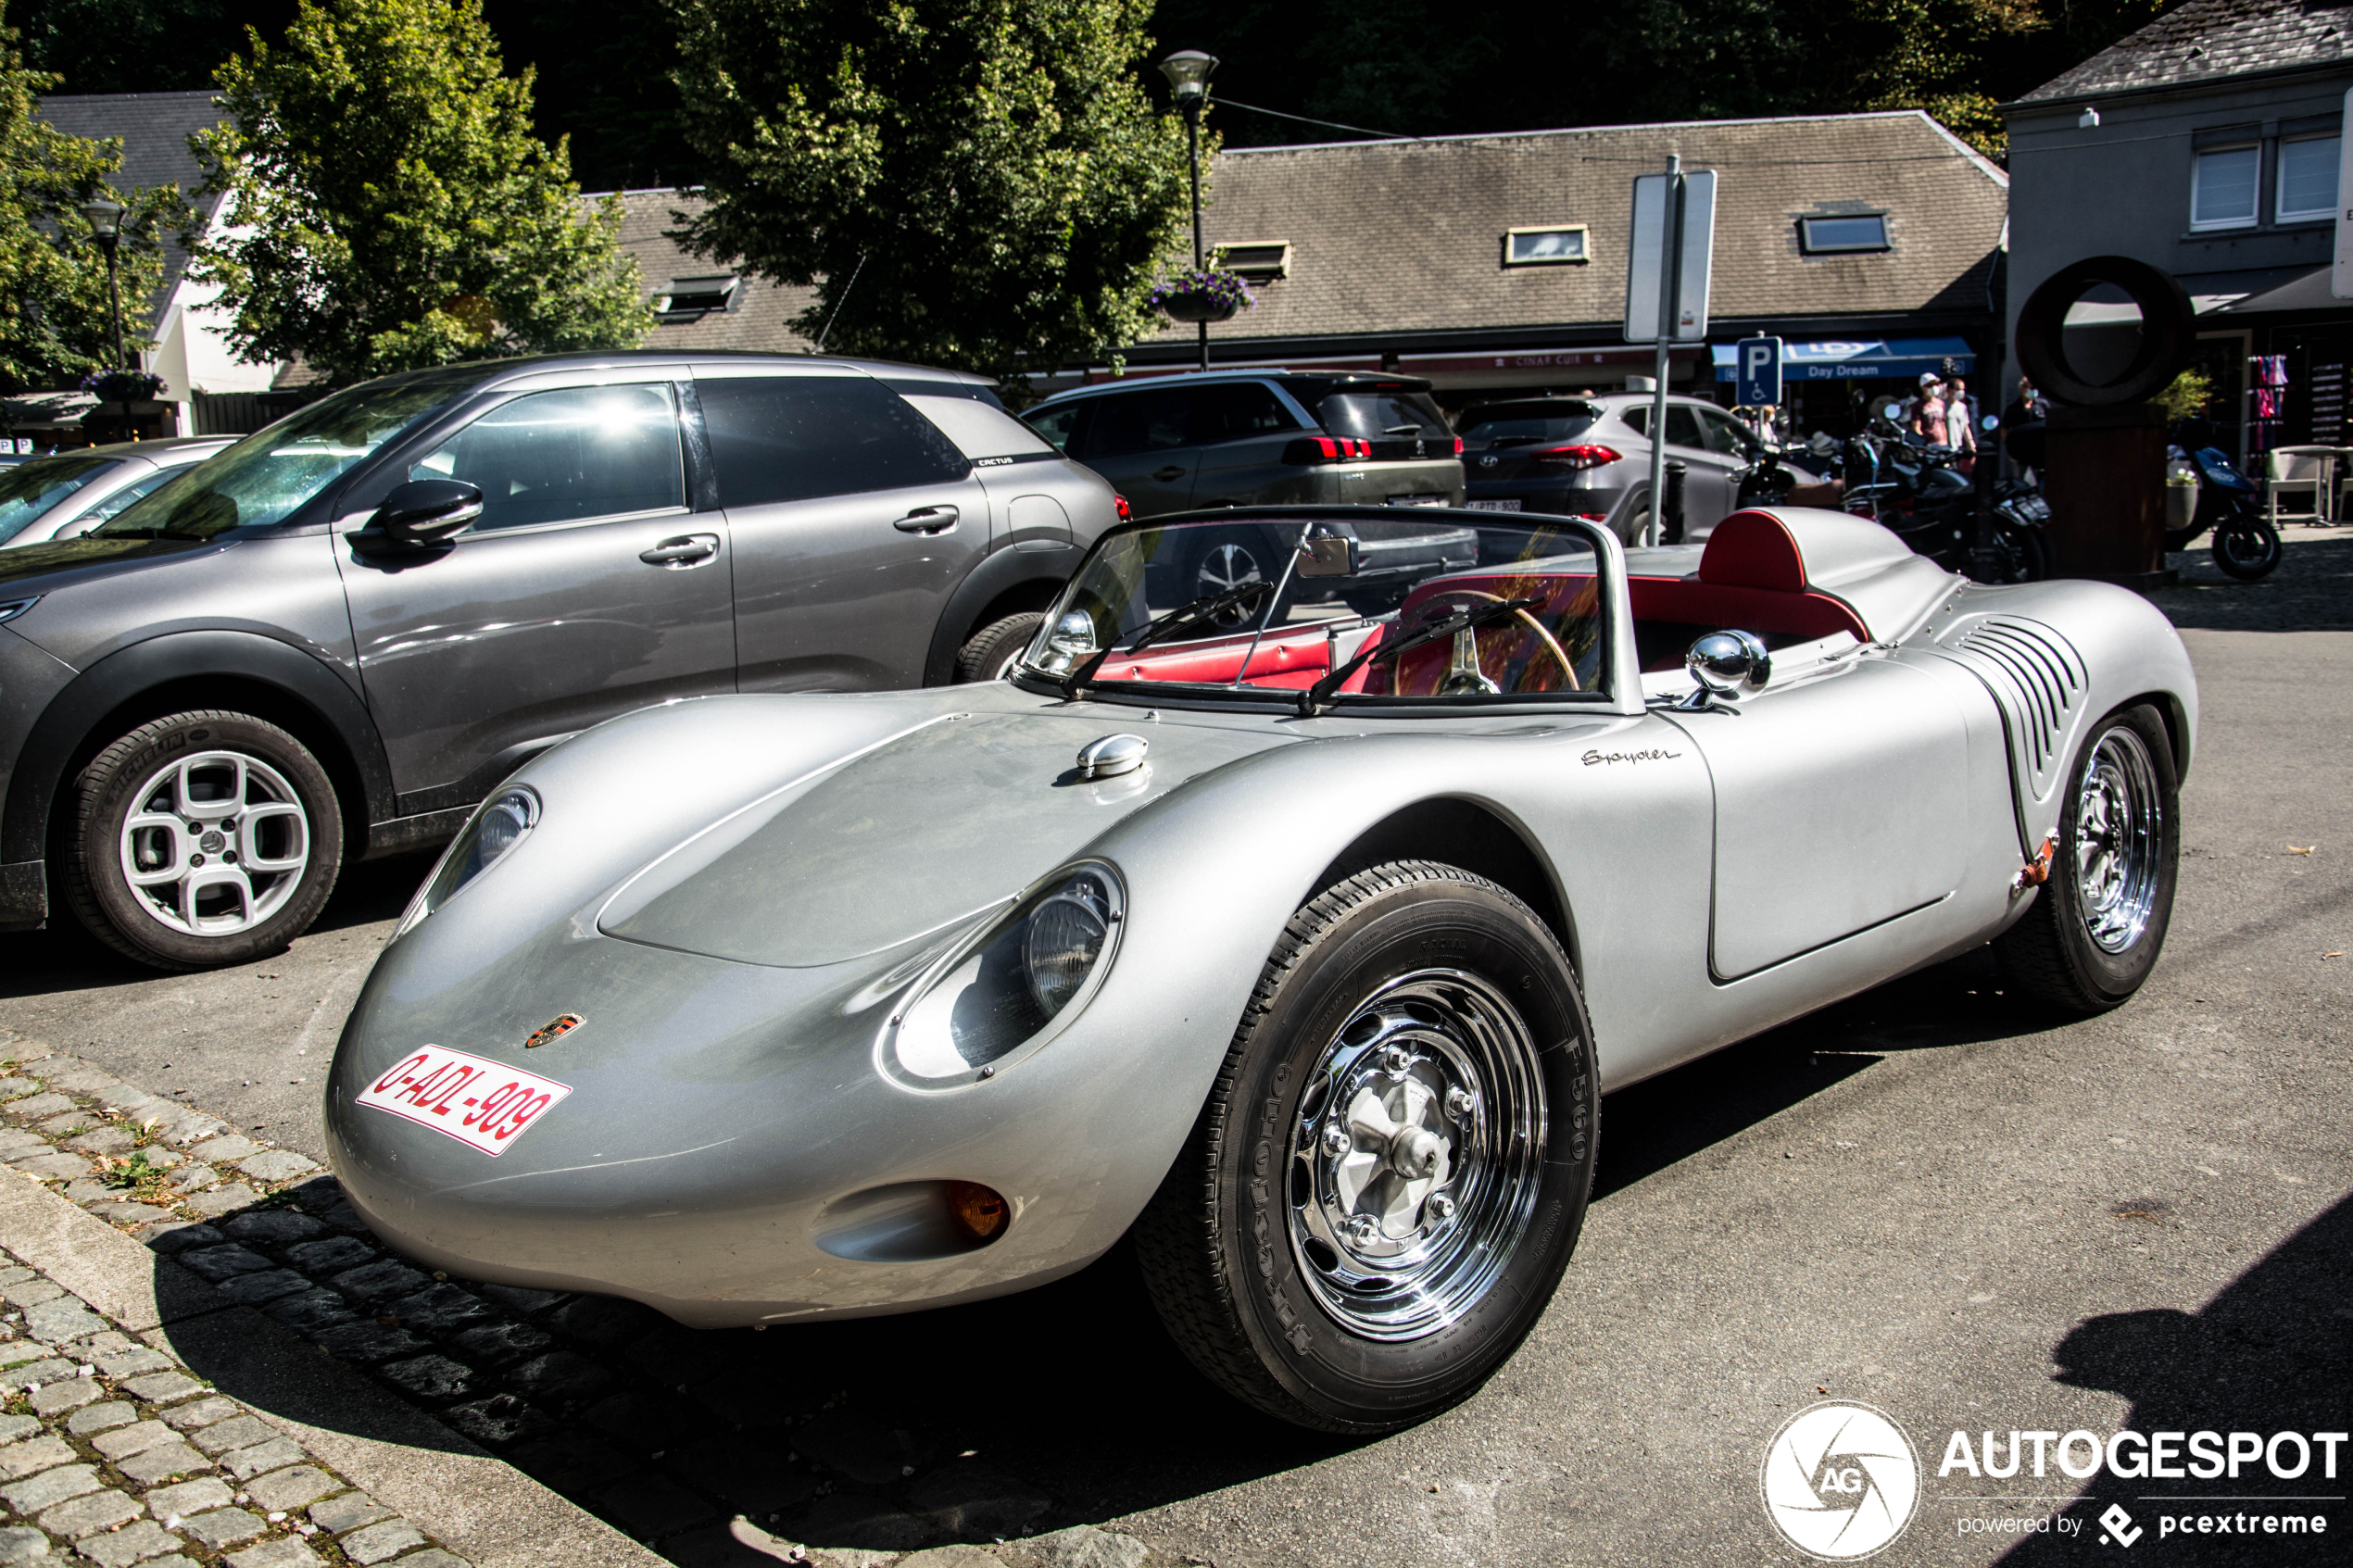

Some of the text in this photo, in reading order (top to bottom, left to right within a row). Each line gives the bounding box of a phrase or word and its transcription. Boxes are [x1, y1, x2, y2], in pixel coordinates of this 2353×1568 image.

[1747, 345, 1771, 381] P
[1808, 365, 1879, 379] Day Dream
[1, 441, 8, 450] P
[20, 440, 28, 450] P
[978, 457, 1013, 467] CACTUS
[1581, 748, 1682, 766] Spyder
[108, 732, 185, 804] MICHELIN
[1563, 1035, 1588, 1161] F-560
